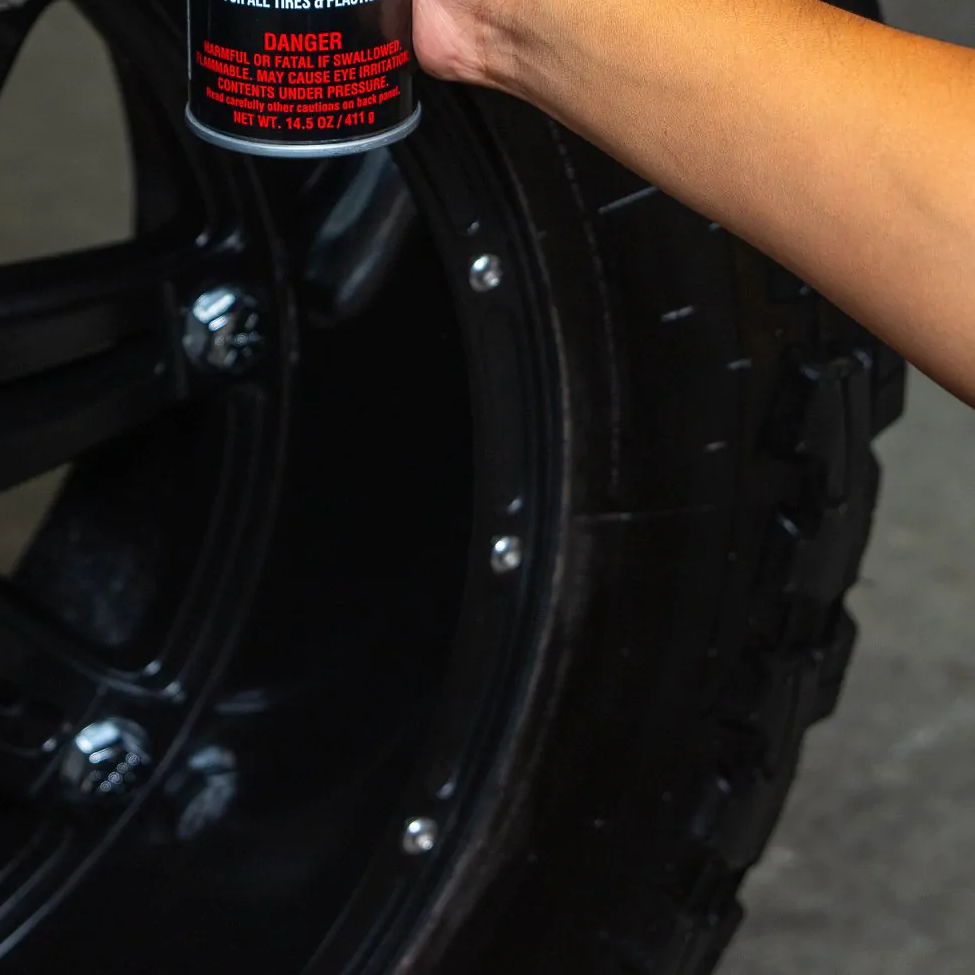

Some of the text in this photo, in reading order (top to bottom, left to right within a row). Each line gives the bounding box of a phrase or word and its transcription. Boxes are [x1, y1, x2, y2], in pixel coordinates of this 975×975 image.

[203, 39, 250, 65] HARMFUL
[253, 53, 271, 67] OR
[274, 55, 314, 68] FATAL
[317, 55, 330, 68] IF
[264, 32, 342, 52] DANGER
[196, 51, 253, 81] FLAMMABLE.
[257, 69, 284, 84] MAY
[288, 71, 330, 85] CAUSE
[334, 67, 356, 83] EYE
[206, 86, 401, 113] Read carefully other cautions on back panel.
[217, 75, 389, 100] CONTENTS UNDER PRESSURE.
[233, 110, 375, 130] NET WT. 14.5 OZ / 411 g
